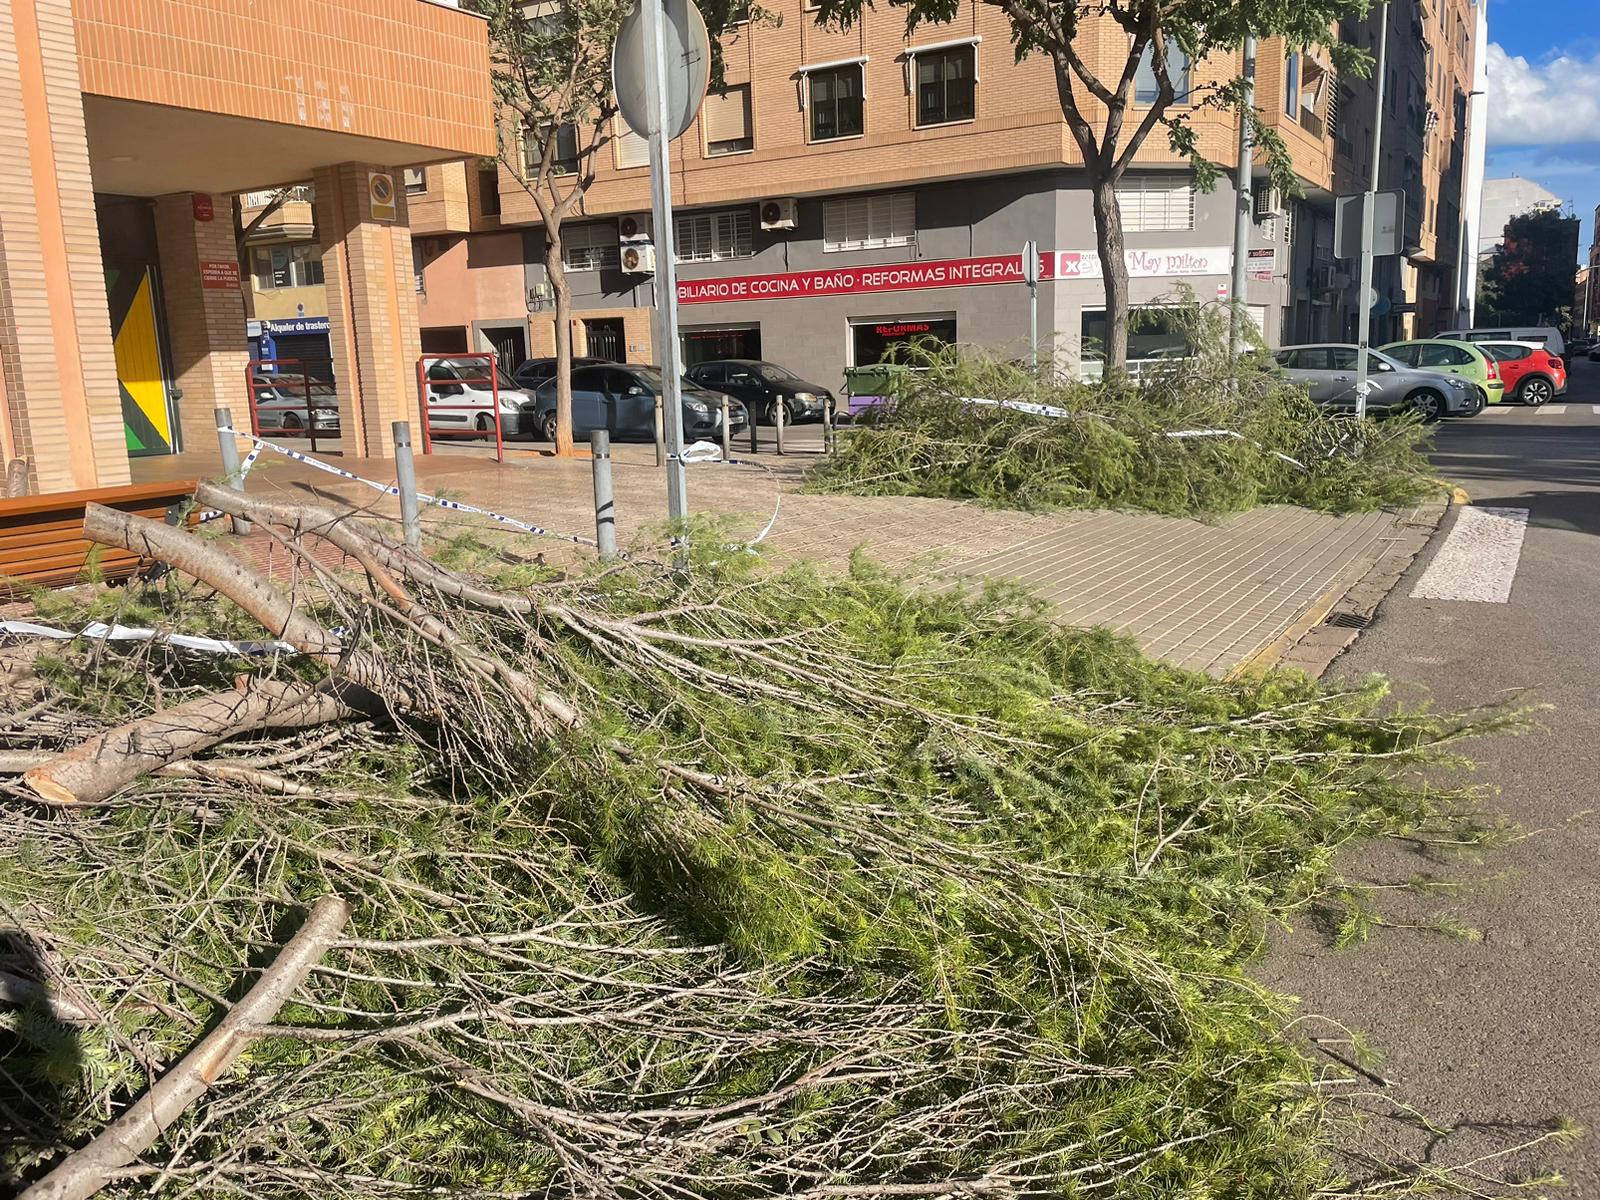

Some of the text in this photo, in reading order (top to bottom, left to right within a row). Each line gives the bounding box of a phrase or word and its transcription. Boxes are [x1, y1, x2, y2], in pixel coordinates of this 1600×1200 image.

[1128, 251, 1162, 274] May
[678, 259, 1045, 299] BILIARIO DE COCINA Y BAÑO REFORMAS INTEGRALS
[270, 322, 295, 334] Alquiler
[296, 322, 305, 331] de
